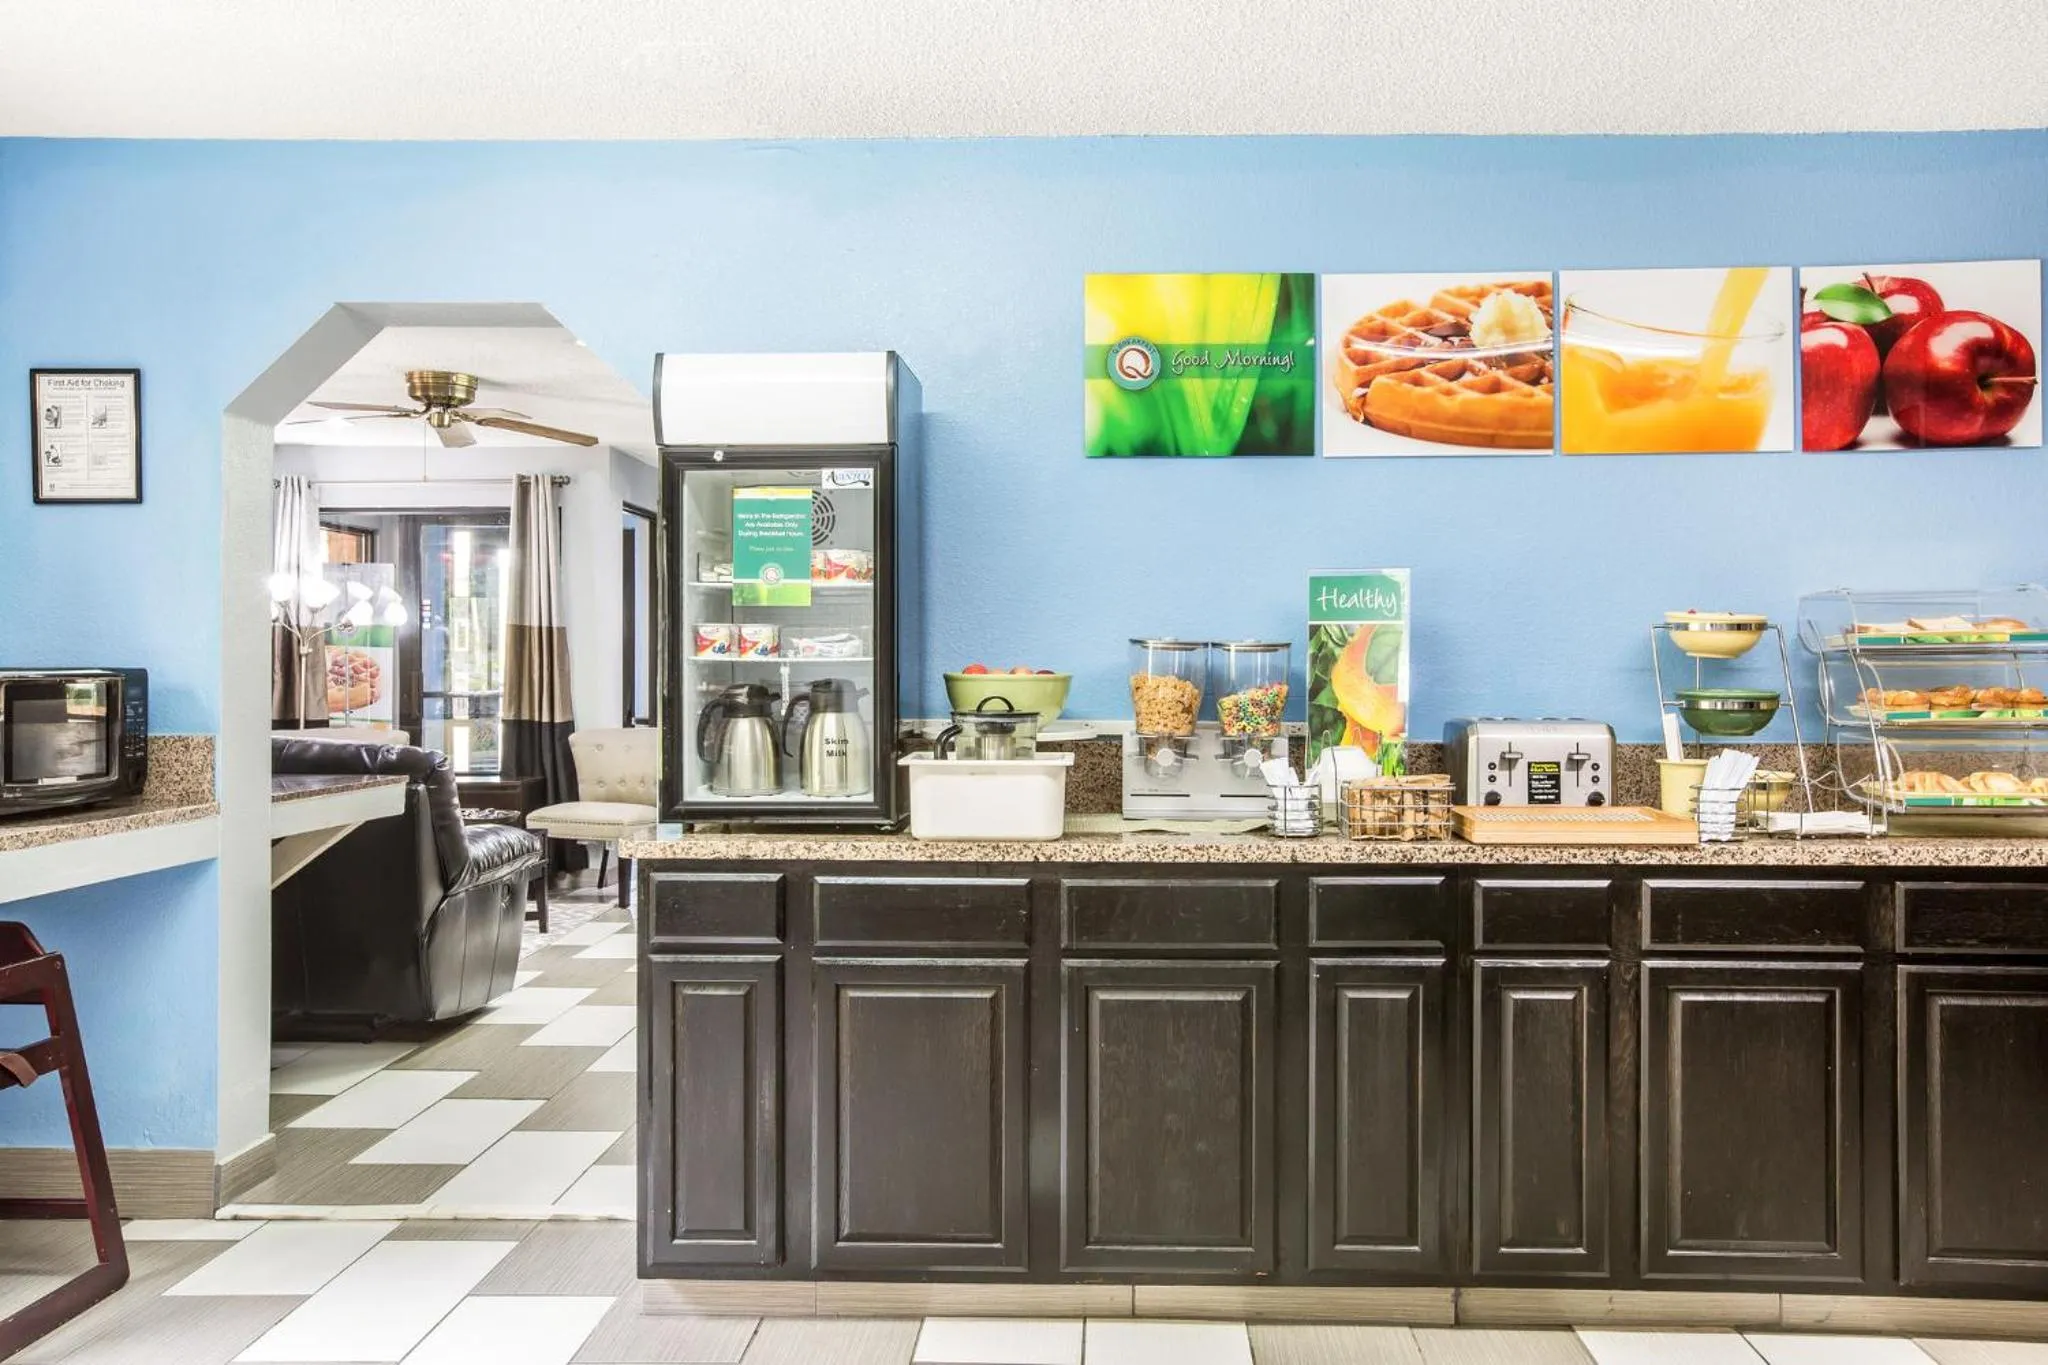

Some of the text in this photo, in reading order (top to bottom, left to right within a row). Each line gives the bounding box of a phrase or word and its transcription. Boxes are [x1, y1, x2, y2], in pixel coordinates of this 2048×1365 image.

[1171, 349, 1295, 375] Good Morning!
[47, 379, 65, 387] First
[66, 379, 80, 387] Aid
[80, 379, 91, 387] for
[93, 379, 125, 389] Choking
[1316, 586, 1398, 617] Healthy
[824, 737, 849, 745] Skim
[826, 749, 847, 757] Milk
